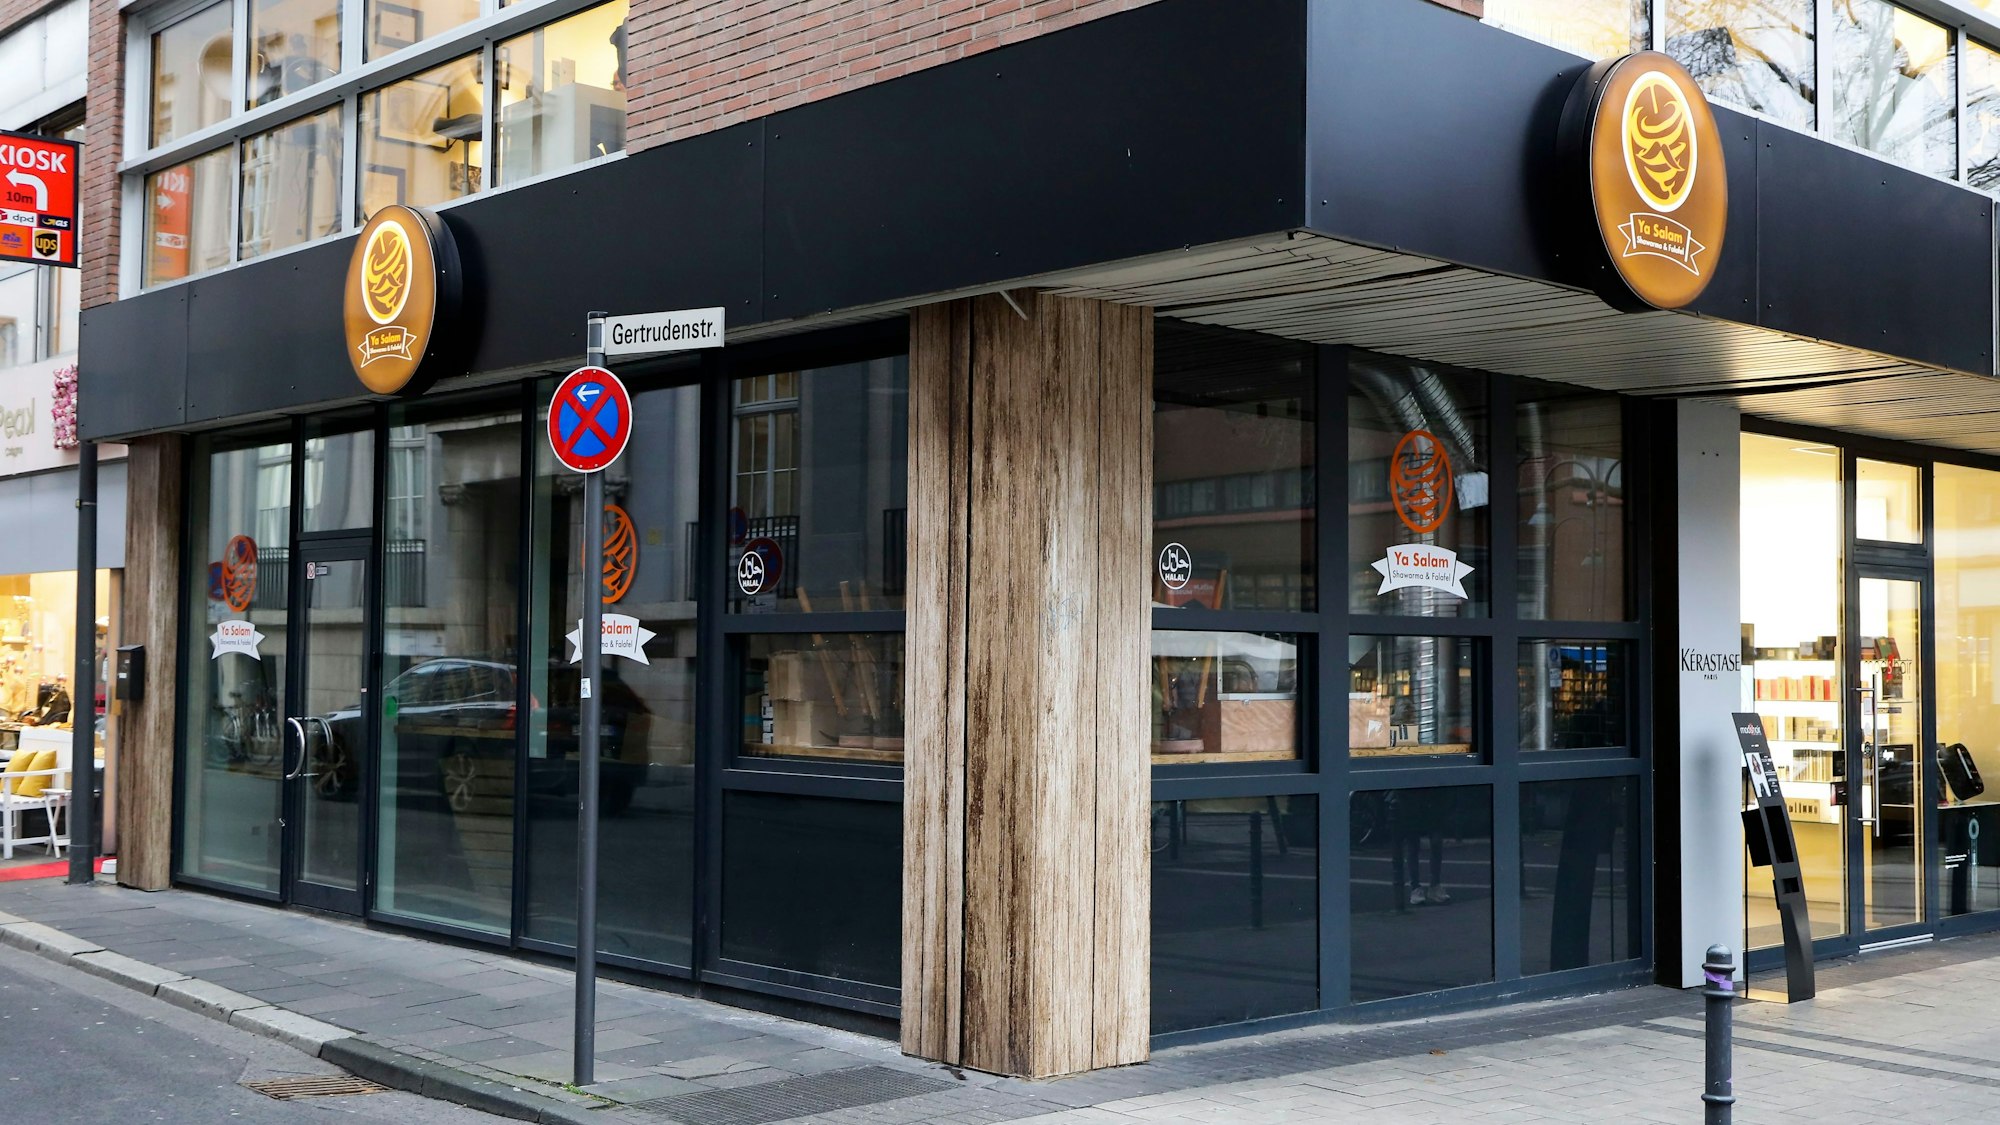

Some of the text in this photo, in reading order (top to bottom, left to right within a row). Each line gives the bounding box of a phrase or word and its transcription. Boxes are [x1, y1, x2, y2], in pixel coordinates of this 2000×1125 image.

[6, 191, 33, 204] 10m
[13, 214, 34, 223] dpd
[1638, 219, 1683, 244] Ya Salam
[1636, 235, 1684, 256] Shawarma & Falafel
[371, 332, 401, 346] Ya Salam
[612, 319, 717, 345] Gertrudenstr.
[740, 556, 762, 579] حلال
[1162, 548, 1189, 572] حلال
[1394, 551, 1449, 568] Ya Salam
[1165, 573, 1185, 582] HALAL
[1392, 570, 1450, 582] Shawarma & Falafel
[221, 624, 251, 636] Ya Salam
[601, 619, 632, 635] Salam
[610, 640, 614, 648] &
[616, 640, 632, 648] Falafel
[1681, 648, 1741, 672] KÉRASTASE
